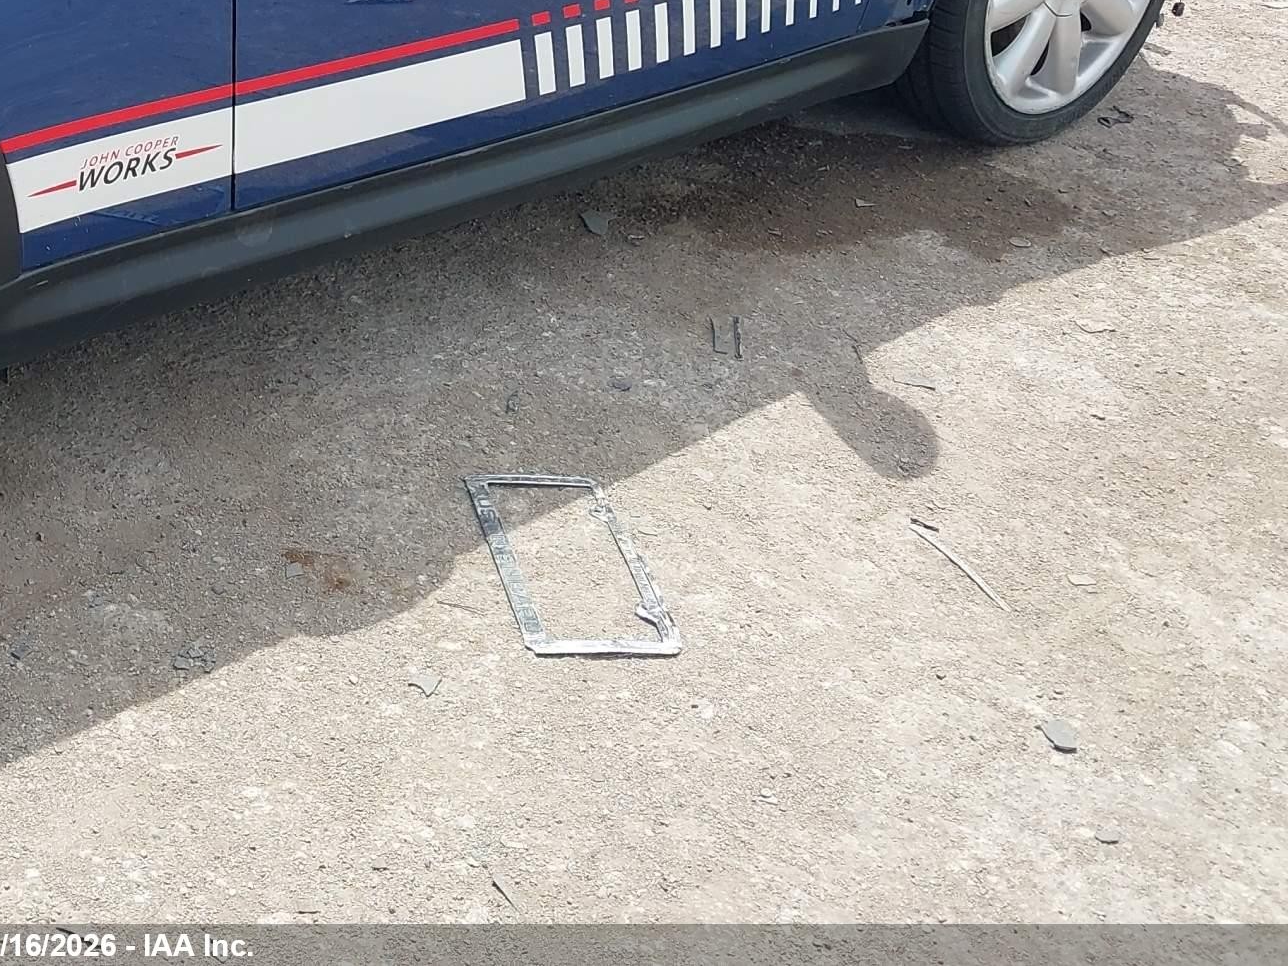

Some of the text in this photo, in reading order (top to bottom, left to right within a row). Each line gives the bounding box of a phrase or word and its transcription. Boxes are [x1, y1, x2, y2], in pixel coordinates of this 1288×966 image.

[78, 147, 177, 192] WORKS
[80, 136, 179, 170] JOHN COOPER
